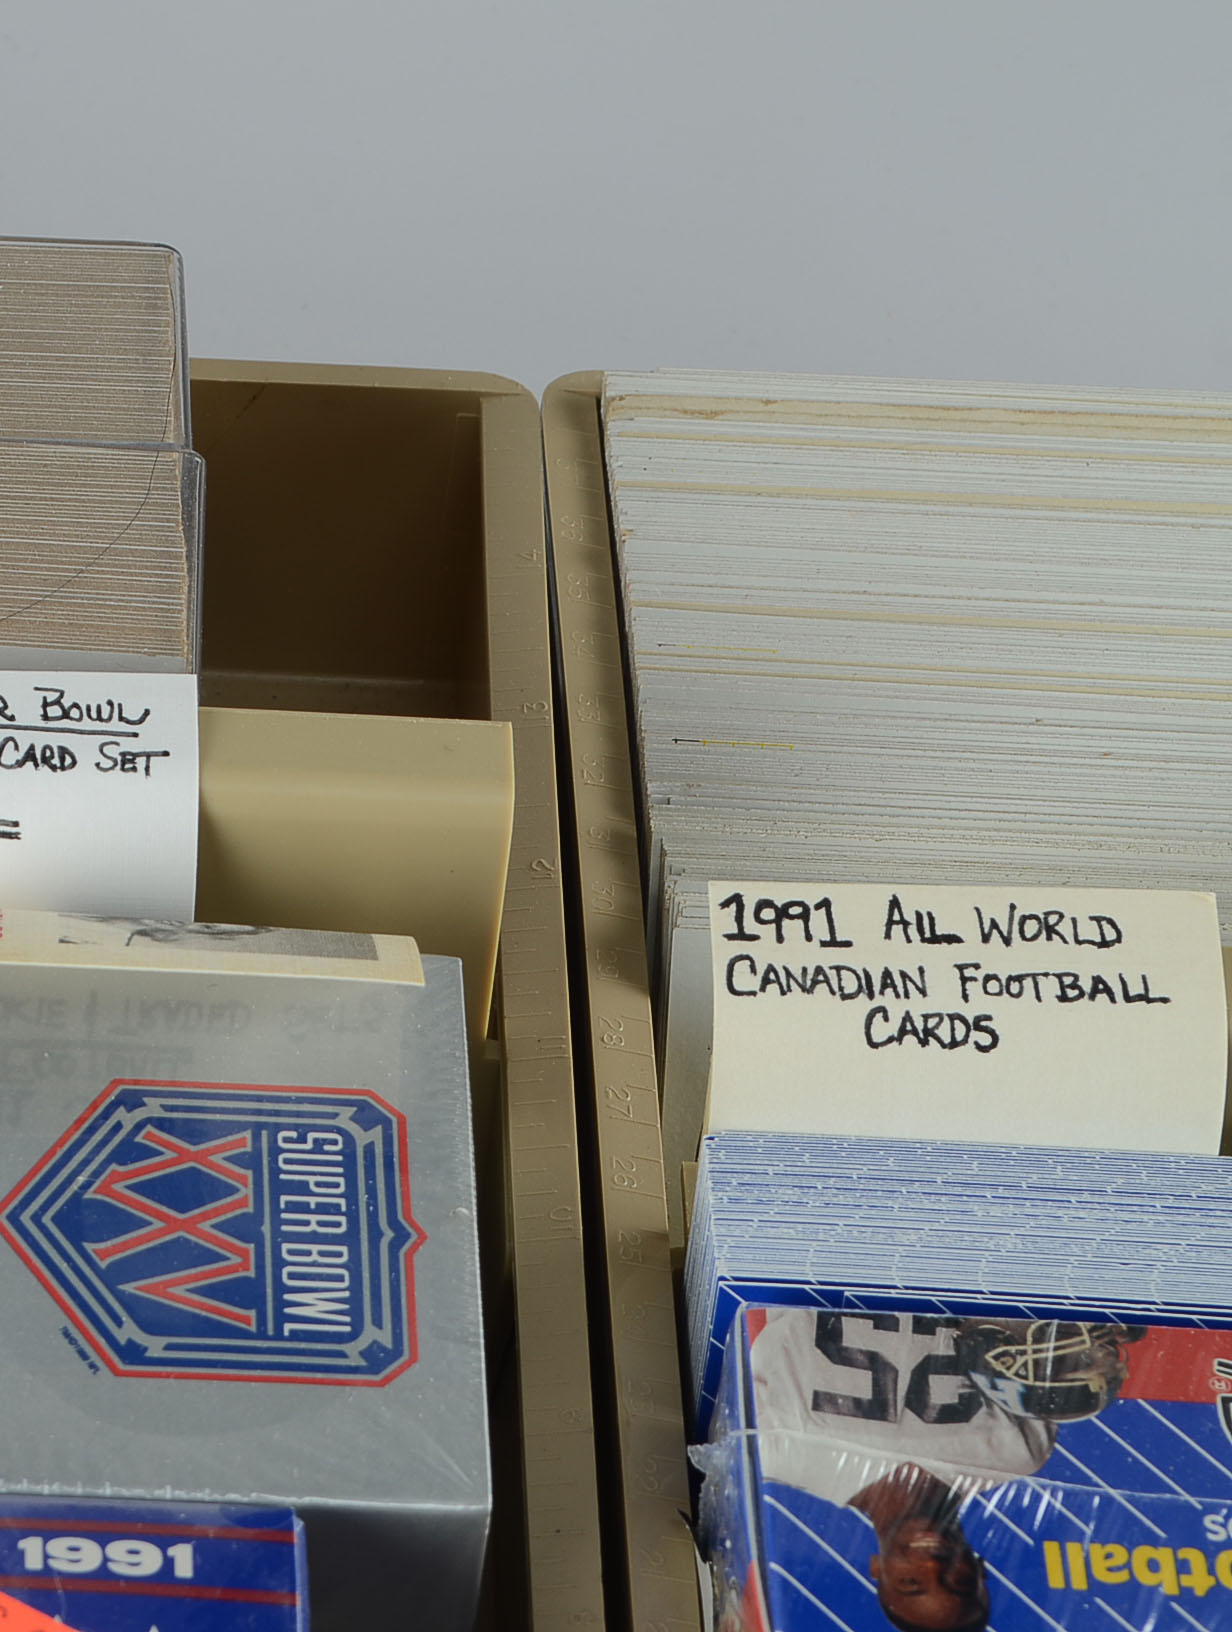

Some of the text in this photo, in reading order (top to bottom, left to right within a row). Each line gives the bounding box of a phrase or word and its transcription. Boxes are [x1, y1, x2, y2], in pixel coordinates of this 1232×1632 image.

[34, 686, 150, 726] BOWL
[95, 741, 170, 779] SET
[718, 892, 1123, 949] 1991 ALL WORLD
[726, 953, 1172, 1005] CANADIAN FOOTBALL
[864, 1005, 1000, 1054] CARDS
[83, 1124, 256, 1333] XXV
[277, 1130, 352, 1336] SUPER BOWL
[17, 1536, 196, 1579] 1991
